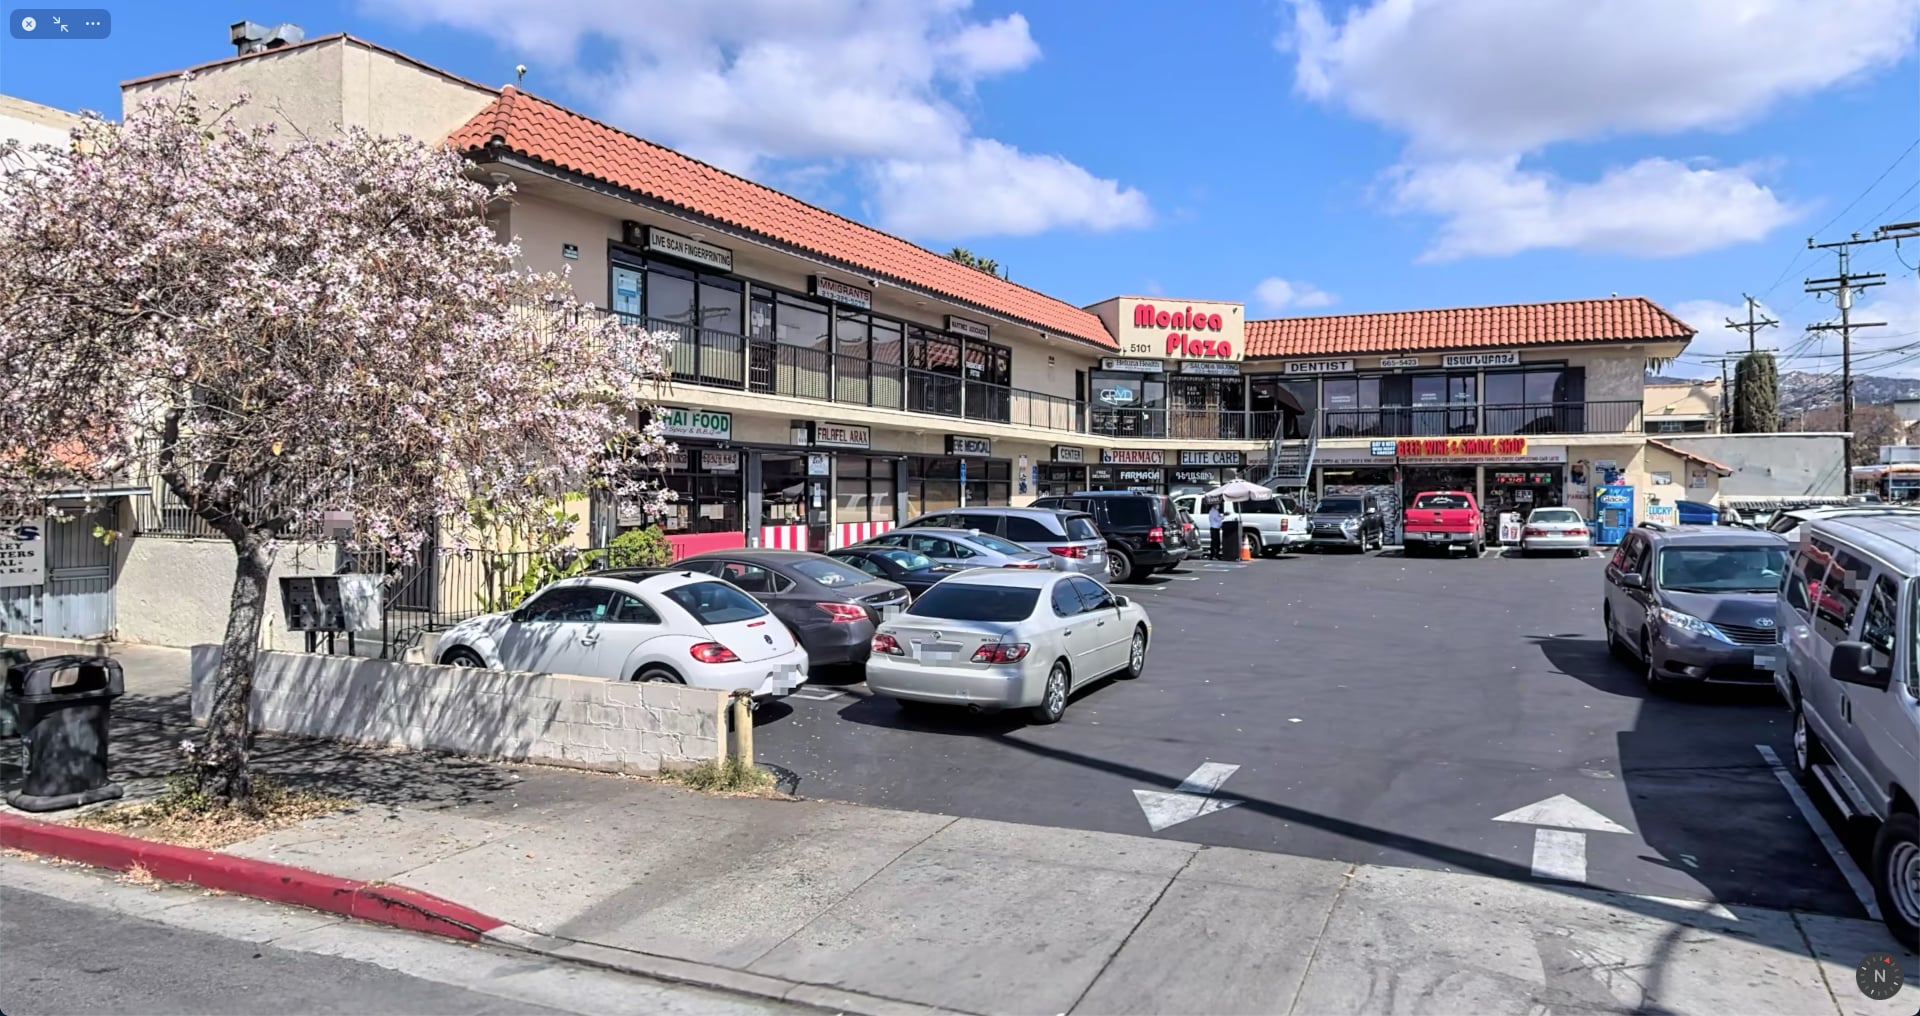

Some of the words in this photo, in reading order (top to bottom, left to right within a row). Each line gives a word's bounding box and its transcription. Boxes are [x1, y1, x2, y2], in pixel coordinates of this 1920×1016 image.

[652, 233, 666, 248] LIVE
[667, 238, 684, 253] SCAN
[684, 243, 731, 266] FINGERPRINTING
[817, 278, 869, 301] IMMIGRANTS
[1134, 303, 1223, 332] Monica
[1130, 343, 1151, 353] 5101
[1166, 332, 1232, 358] Plaza
[1291, 361, 1348, 372] DENTIST
[658, 411, 688, 426] HAI
[692, 413, 729, 432] FOOD
[817, 427, 848, 442] FALAFEL
[849, 430, 868, 443] ARAX
[1397, 440, 1422, 456] BEER
[1423, 440, 1449, 456] WINE
[1460, 438, 1496, 455] SMOKE
[1497, 437, 1526, 455] SHOP
[1060, 448, 1081, 460] CENTER
[1112, 450, 1164, 463] PHARMACY
[1182, 451, 1210, 463] ELITE
[1212, 451, 1239, 464] CARE
[1120, 471, 1160, 480] FARMACIA
[1648, 506, 1673, 515] LUCKY
